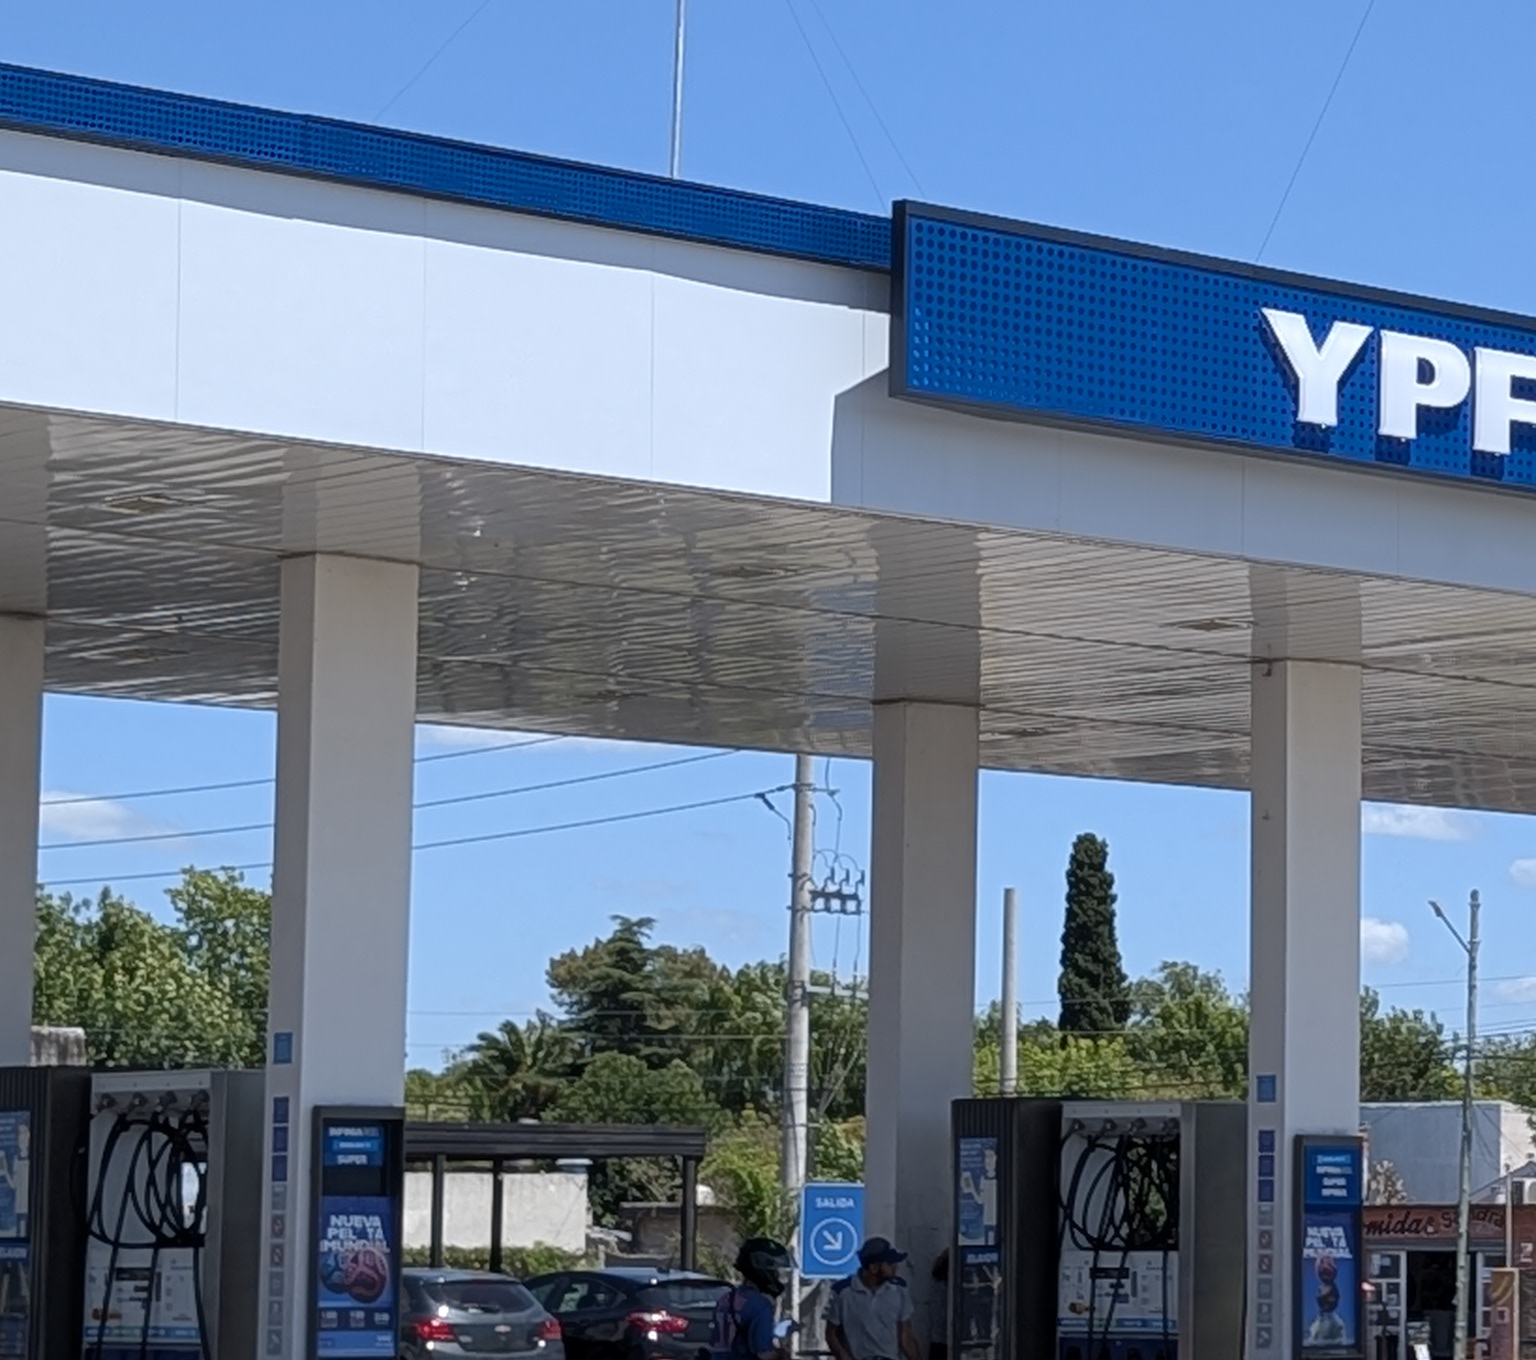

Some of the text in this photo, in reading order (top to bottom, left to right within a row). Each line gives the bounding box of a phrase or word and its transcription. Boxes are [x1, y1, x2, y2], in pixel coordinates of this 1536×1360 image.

[815, 1196, 856, 1208] SALIDA
[330, 1214, 382, 1228] NUEVA
[327, 1227, 385, 1240] PELTA
